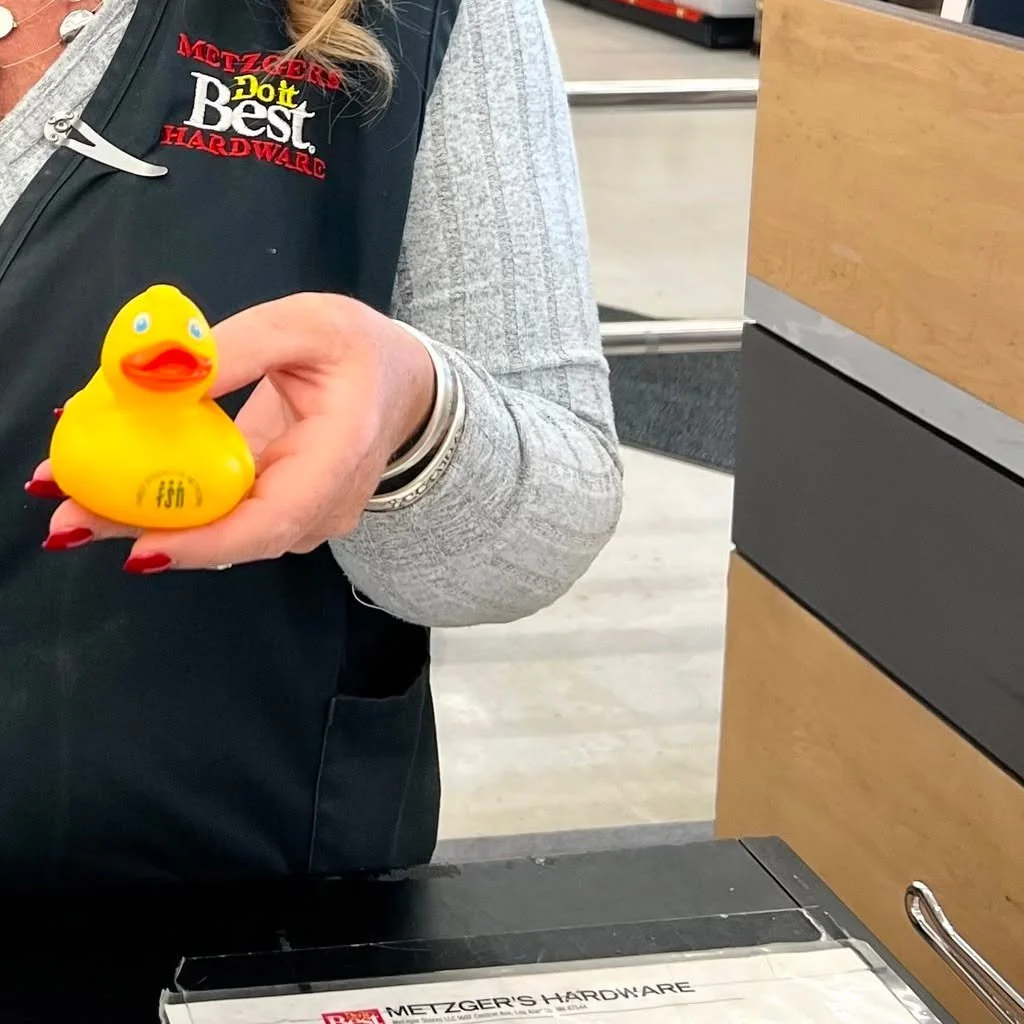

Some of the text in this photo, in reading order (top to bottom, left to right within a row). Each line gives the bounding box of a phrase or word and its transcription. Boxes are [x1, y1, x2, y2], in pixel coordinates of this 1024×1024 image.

[160, 125, 327, 181] HARDWARE
[385, 996, 536, 1018] METZGER'S
[542, 981, 696, 1006] HARDWARE
